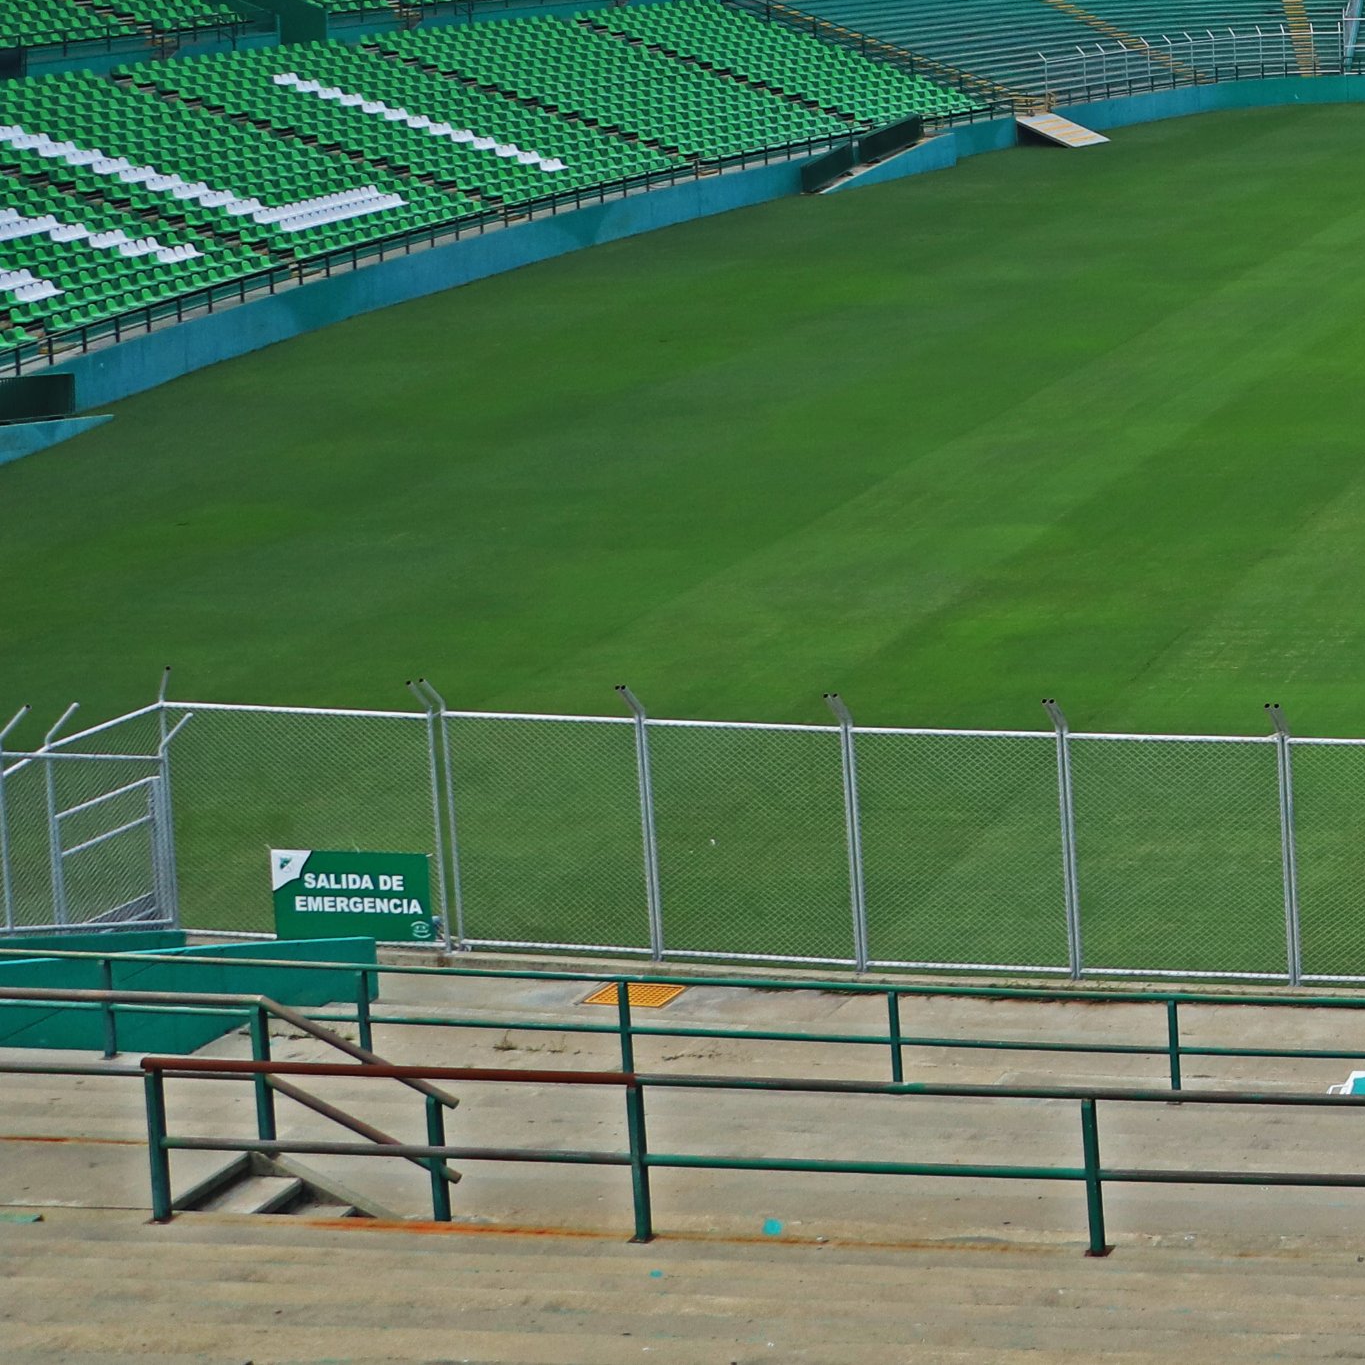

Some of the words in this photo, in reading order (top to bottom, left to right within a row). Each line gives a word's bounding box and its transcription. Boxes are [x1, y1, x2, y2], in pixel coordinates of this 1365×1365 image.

[303, 872, 374, 891] SALIDA
[378, 874, 404, 891] DE
[294, 895, 423, 915] EMERGENCIA
